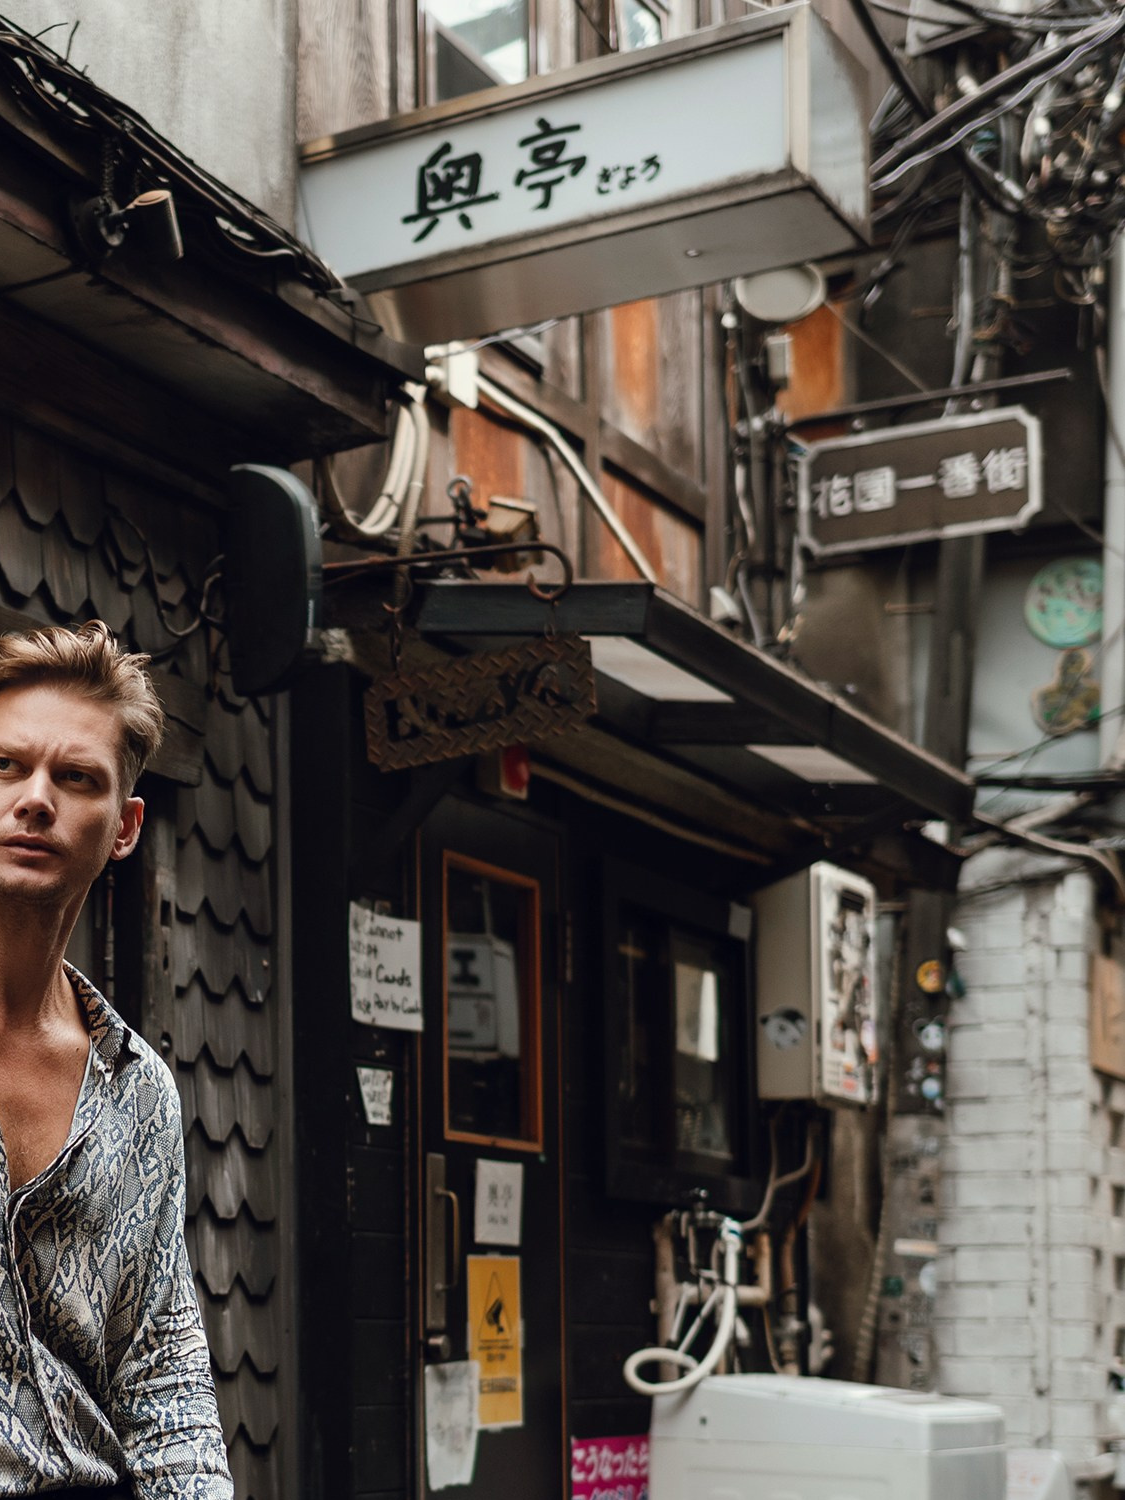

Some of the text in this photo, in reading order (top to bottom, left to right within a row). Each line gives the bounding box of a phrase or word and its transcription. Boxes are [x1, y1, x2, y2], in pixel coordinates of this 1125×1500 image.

[811, 446, 1027, 519] 花園一番街
[571, 1443, 649, 1482] こうなったら
